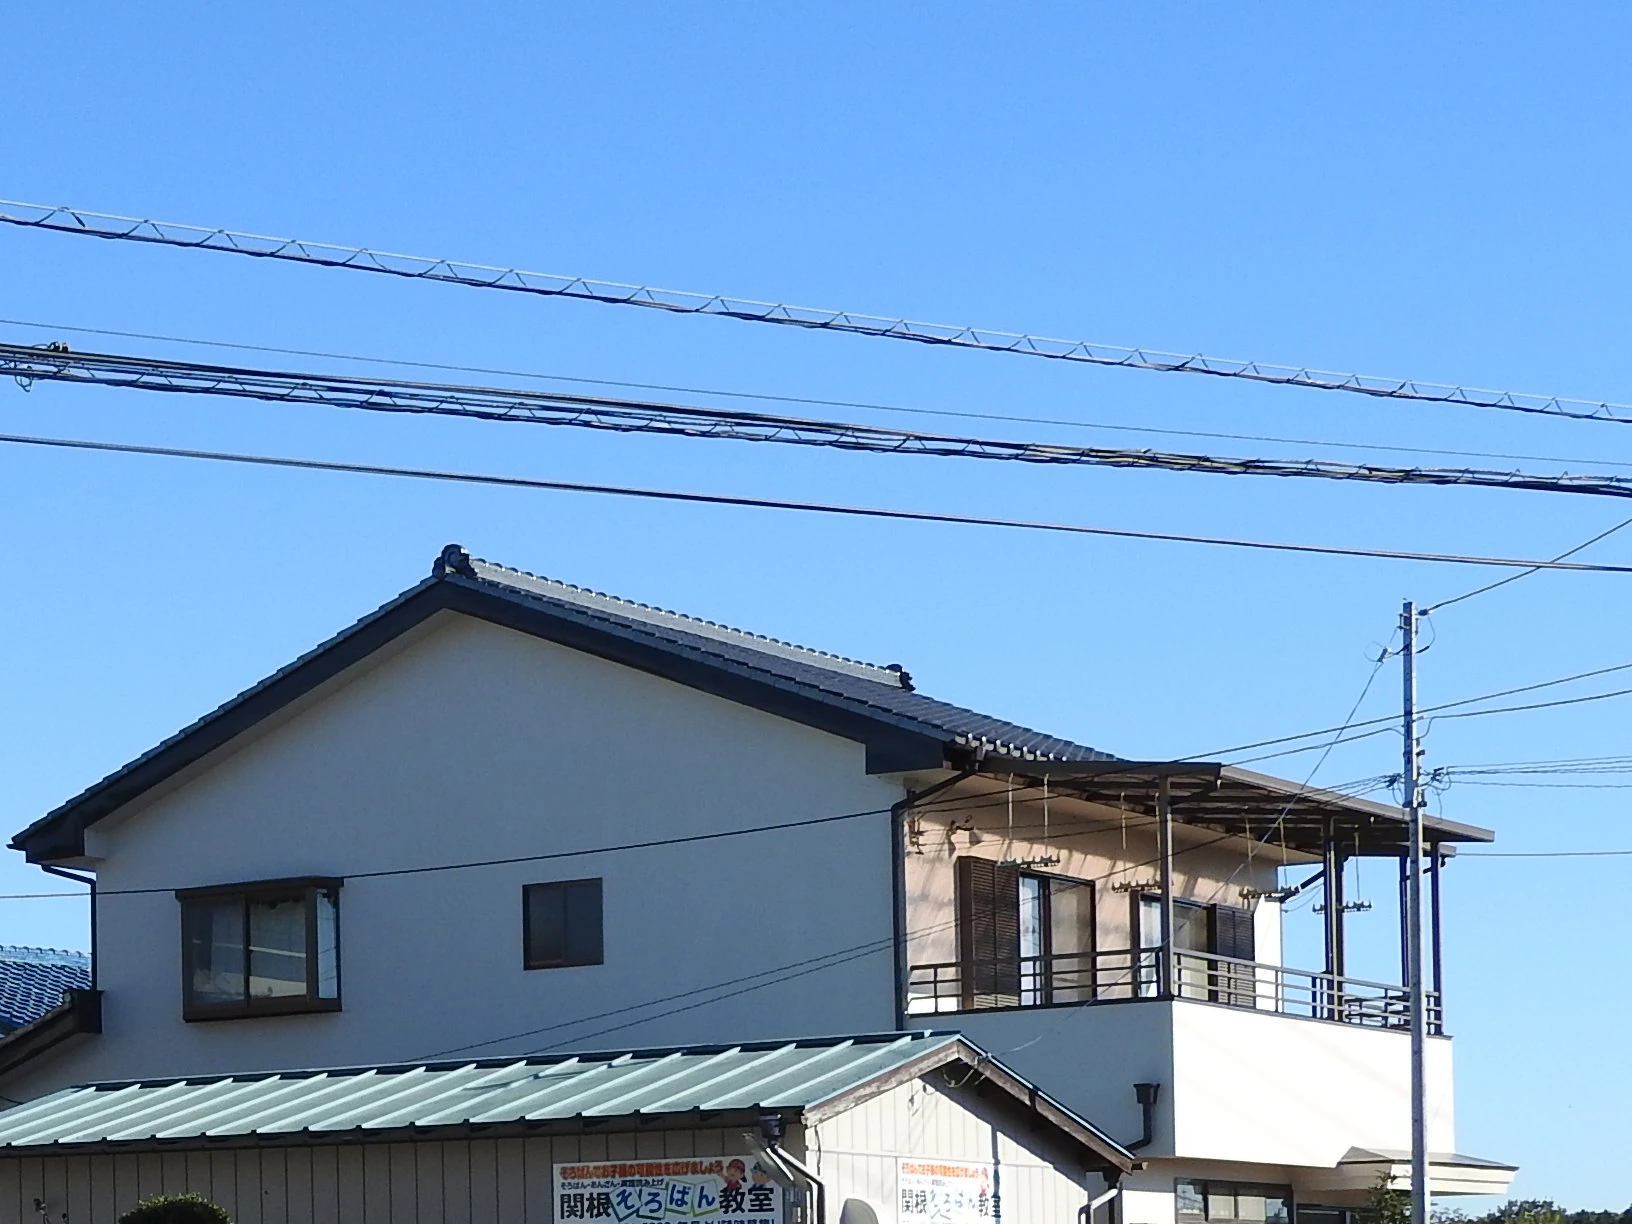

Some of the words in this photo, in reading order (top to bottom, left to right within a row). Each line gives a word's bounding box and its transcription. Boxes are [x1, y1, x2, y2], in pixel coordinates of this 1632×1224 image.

[560, 1186, 775, 1219] 関根そろばん教室
